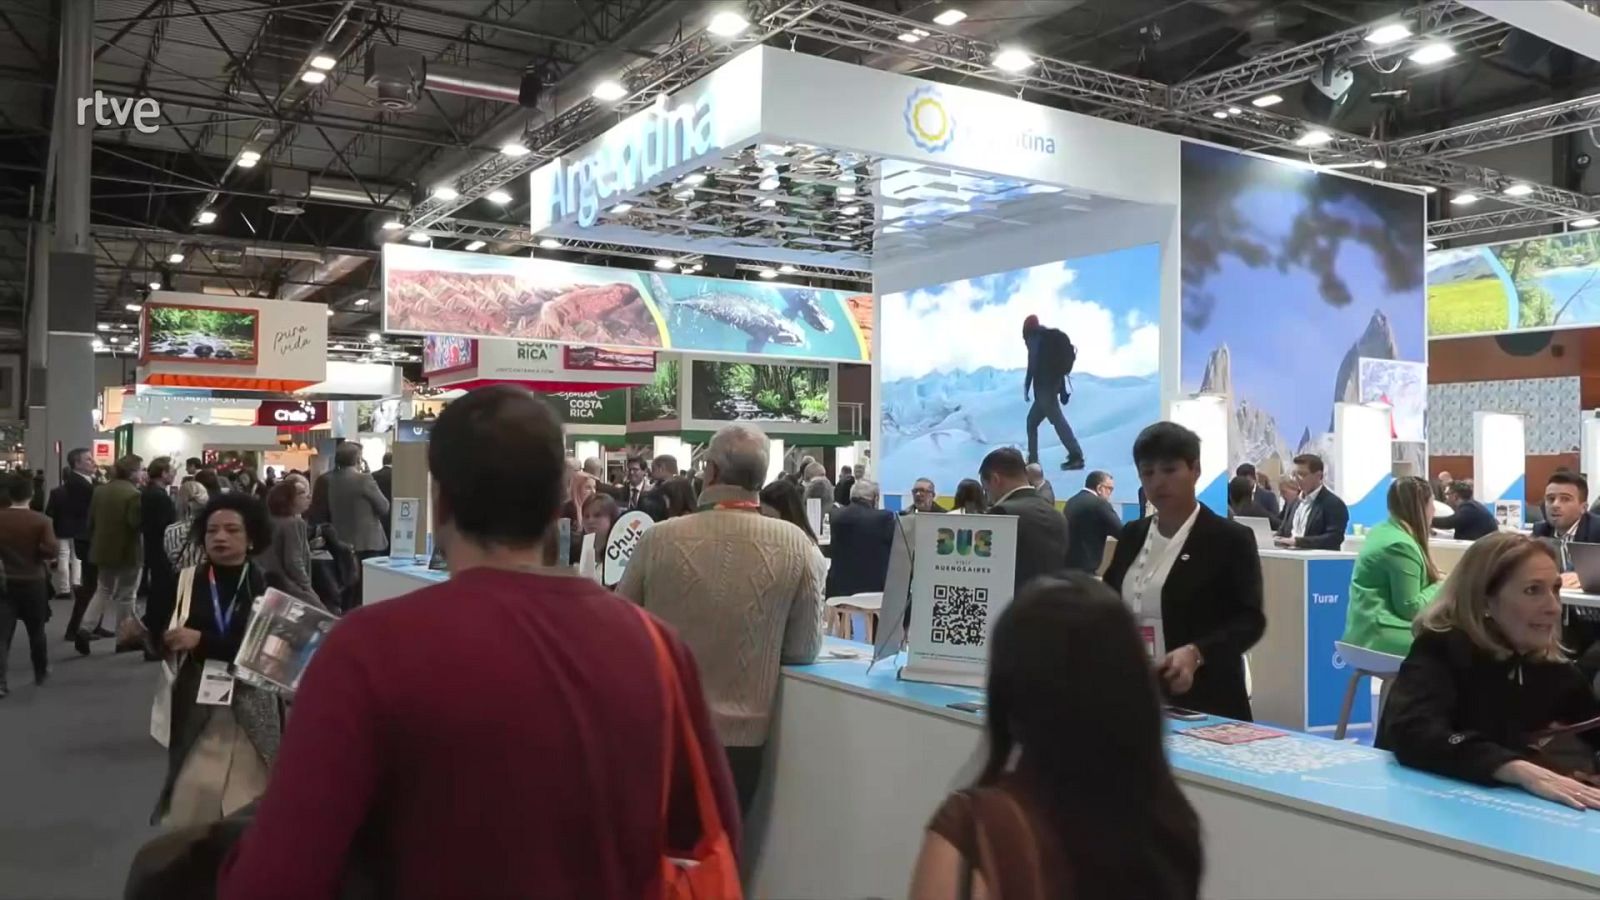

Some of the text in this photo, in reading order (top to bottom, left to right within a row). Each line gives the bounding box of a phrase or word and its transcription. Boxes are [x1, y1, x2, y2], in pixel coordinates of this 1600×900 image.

[517, 348, 547, 360] RICA
[569, 400, 603, 409] COSTA
[569, 408, 594, 417] RICA
[607, 527, 635, 560] Chu
[1312, 593, 1339, 604] Turar
